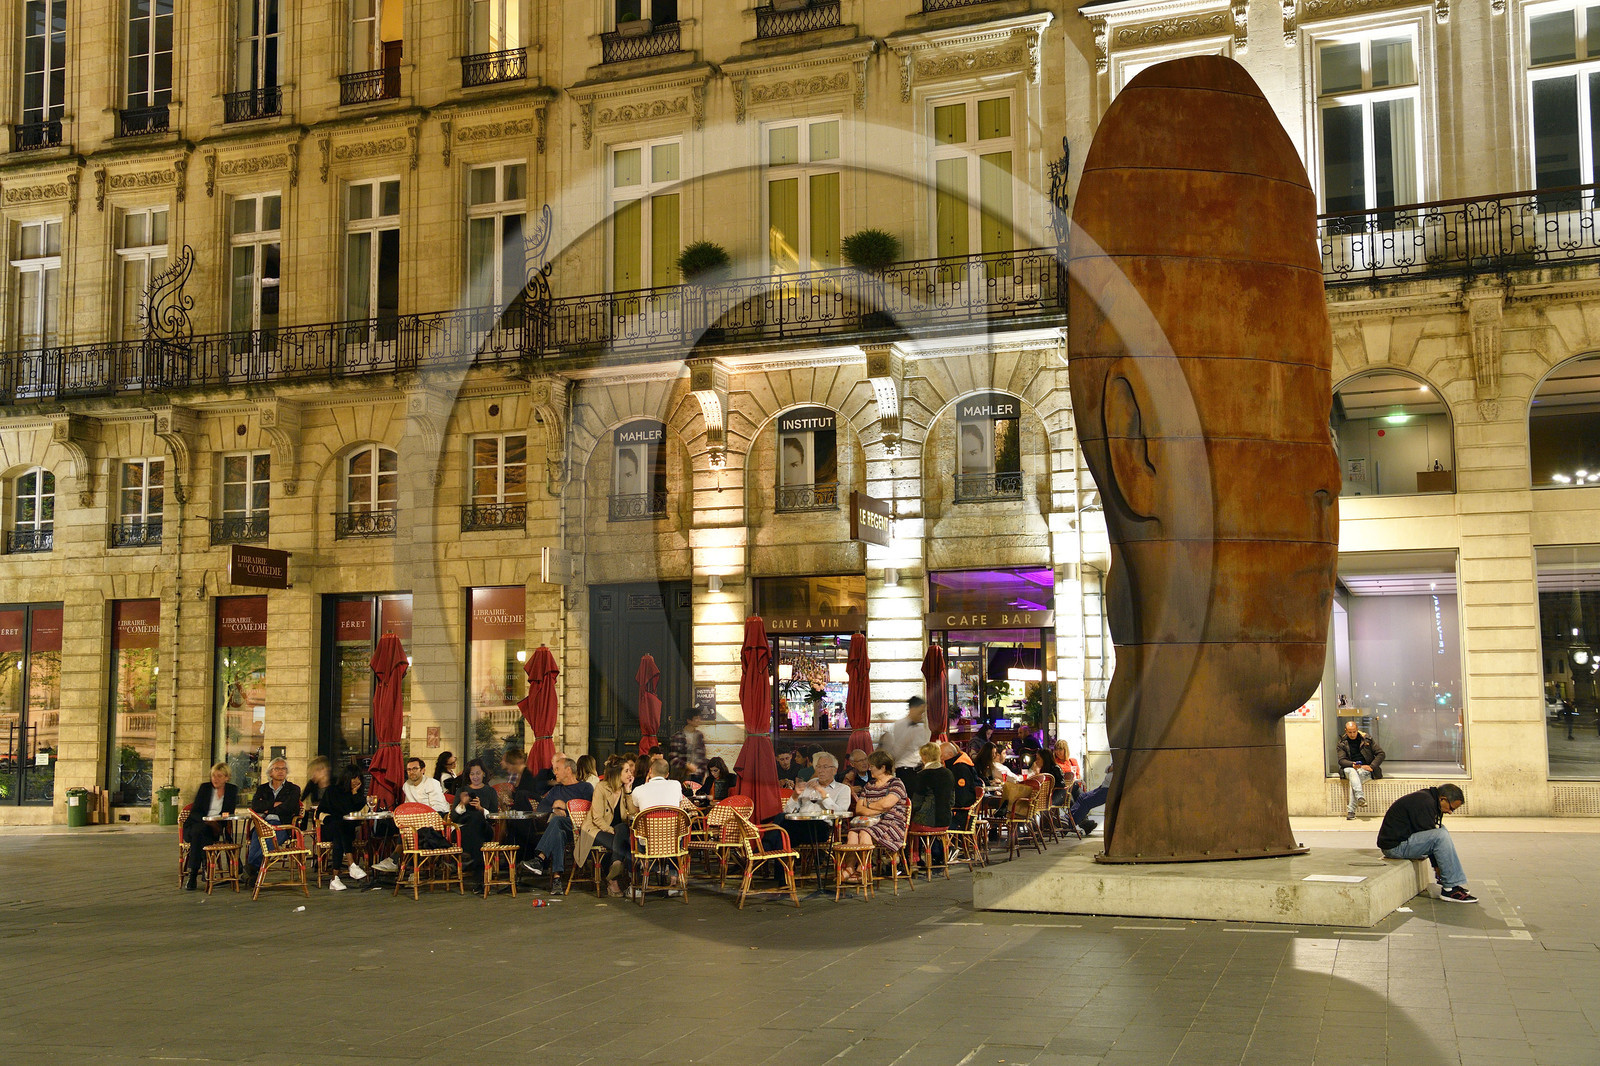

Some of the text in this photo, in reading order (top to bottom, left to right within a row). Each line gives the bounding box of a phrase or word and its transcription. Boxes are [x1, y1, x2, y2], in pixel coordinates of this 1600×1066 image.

[963, 404, 1013, 417] MAHLER
[783, 417, 833, 430] INSTITUT
[620, 430, 662, 442] MAHLER
[859, 508, 889, 532] LE REGENT
[237, 554, 268, 566] LIBRAIRIE
[473, 608, 507, 616] LIBRAIRIE
[118, 619, 147, 627] LIBRAIRIE
[341, 620, 366, 628] FÉRET
[772, 618, 839, 629] CAVE A VIN
[946, 613, 1032, 626] CAFE BAR
